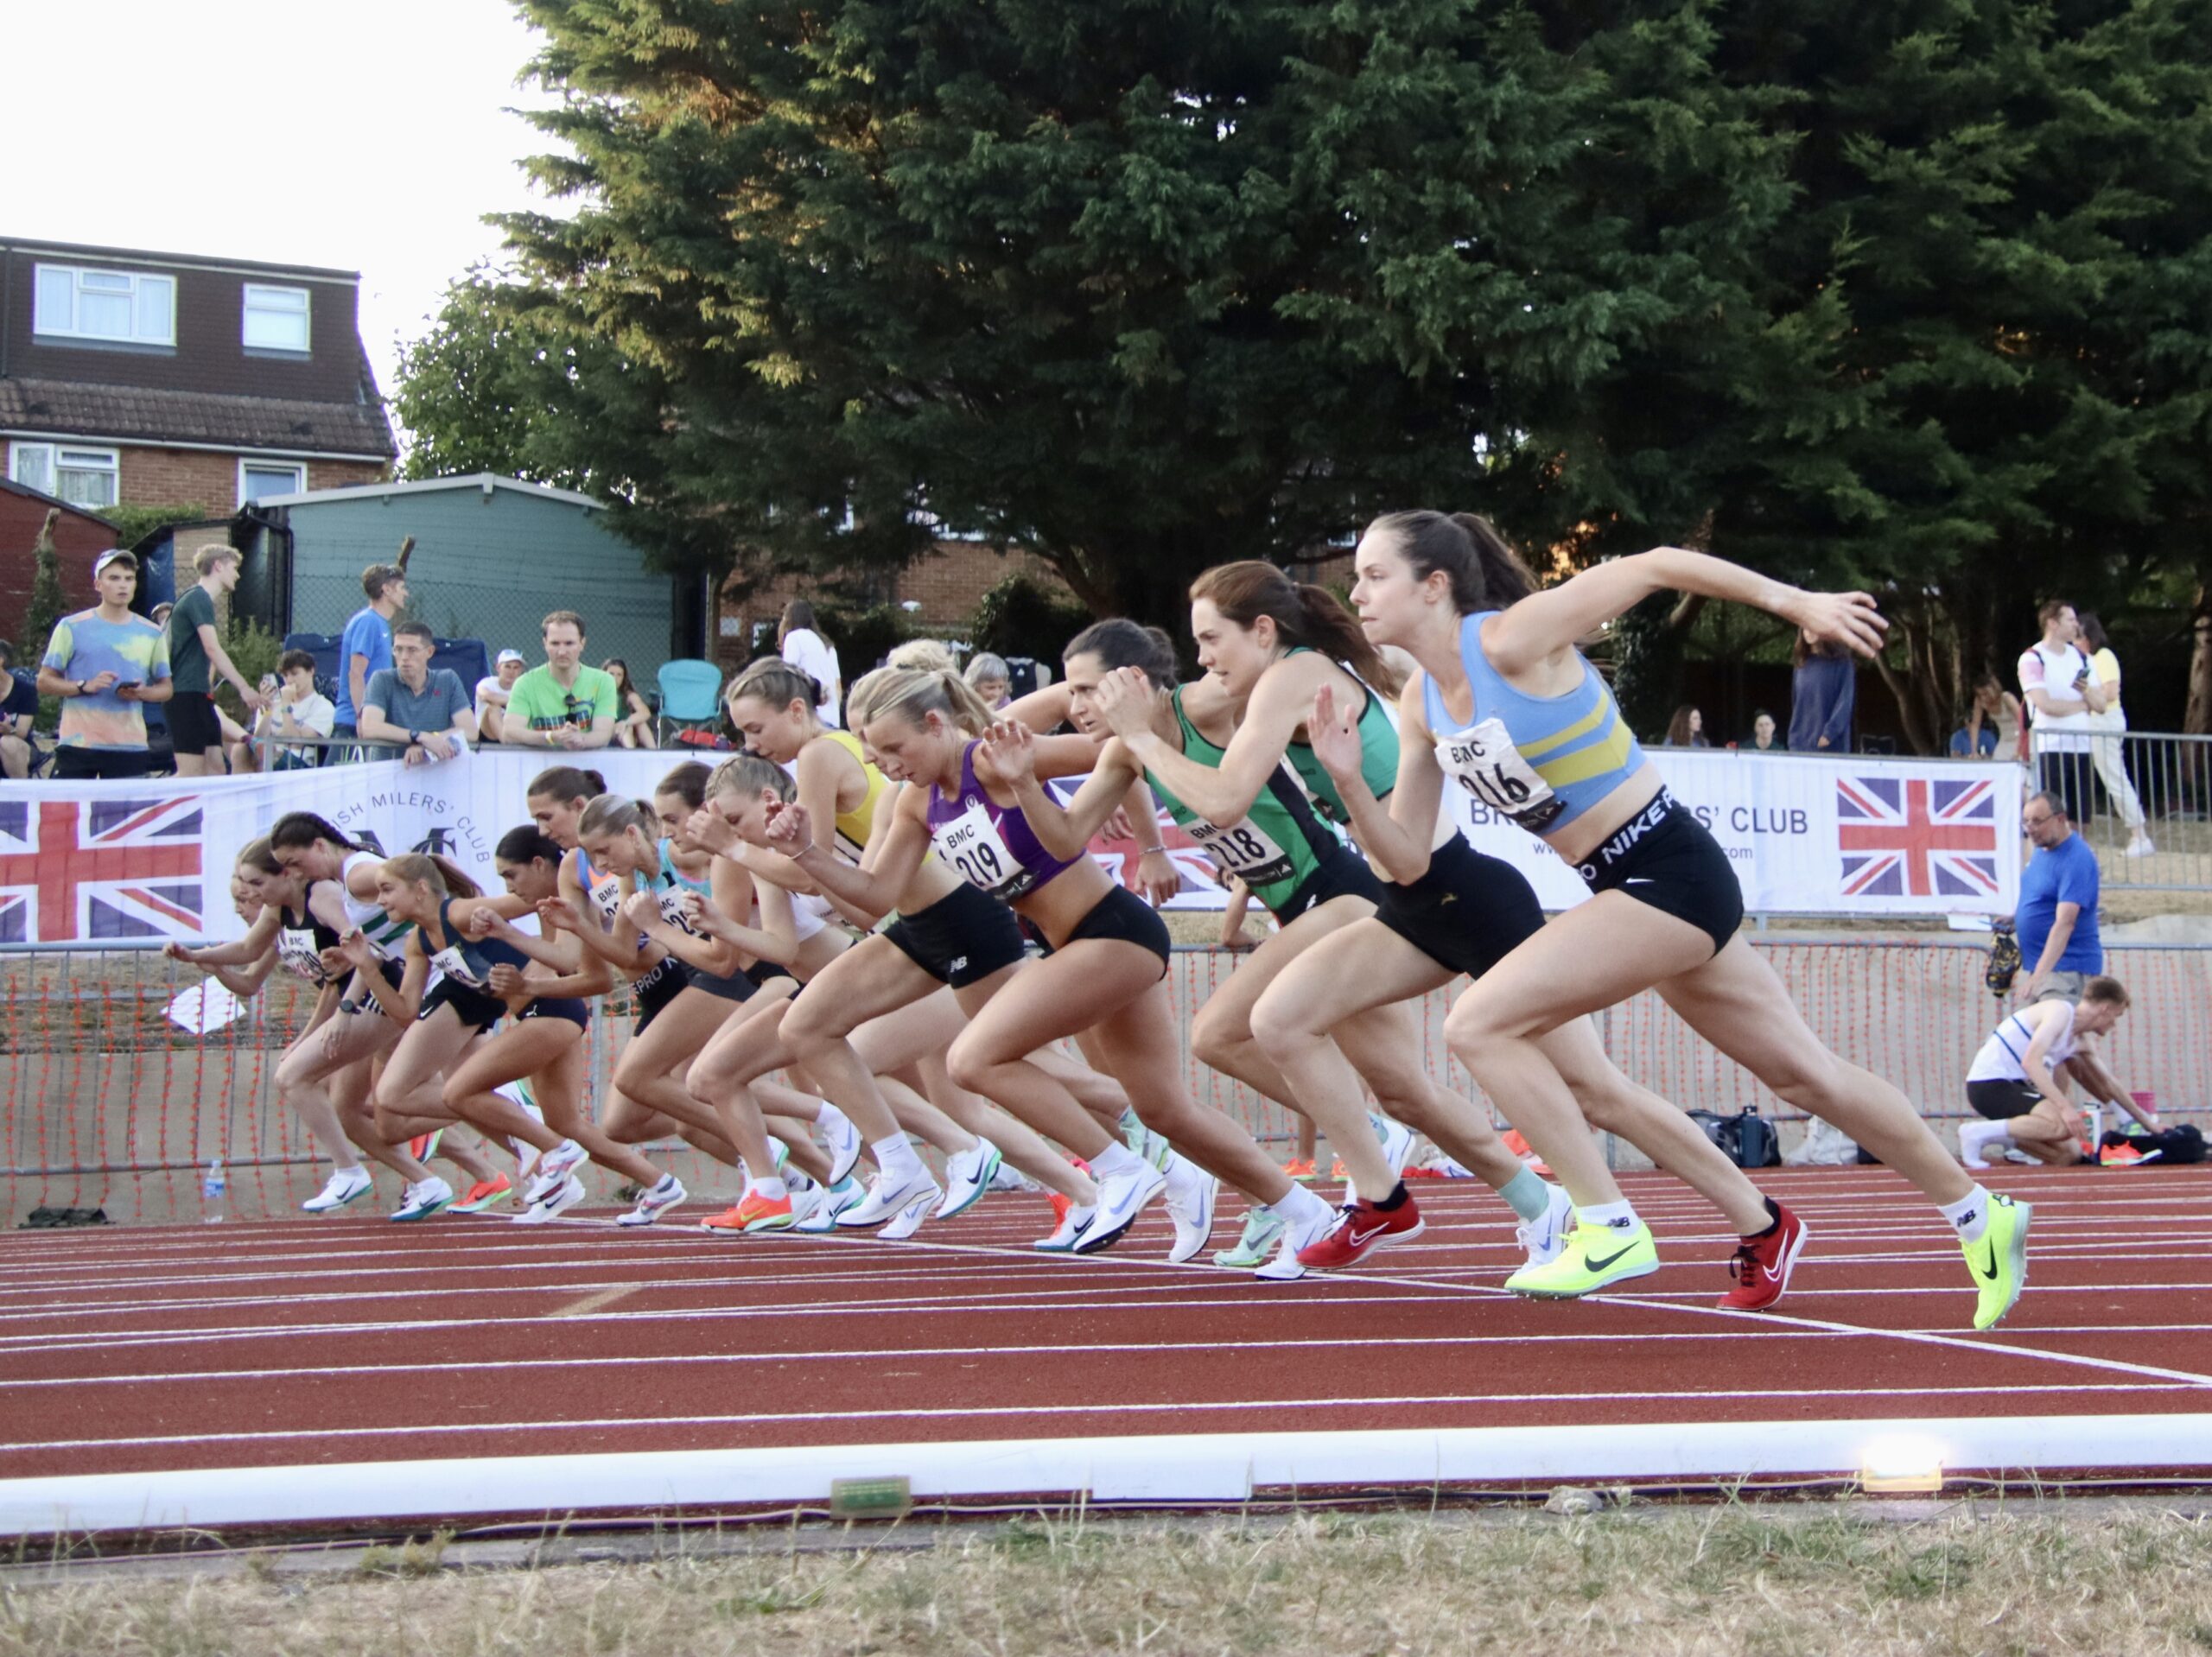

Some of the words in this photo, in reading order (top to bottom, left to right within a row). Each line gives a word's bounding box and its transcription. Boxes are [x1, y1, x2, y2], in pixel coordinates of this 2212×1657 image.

[1450, 740, 1485, 764] BMC
[1459, 762, 1531, 807] 216
[1731, 807, 1808, 835] CLUB
[457, 816, 490, 862] CLUB
[946, 823, 976, 849] BMC
[1204, 828, 1267, 868] 218
[955, 841, 1003, 887] 219
[598, 884, 620, 903] BMC
[660, 897, 676, 912] MC
